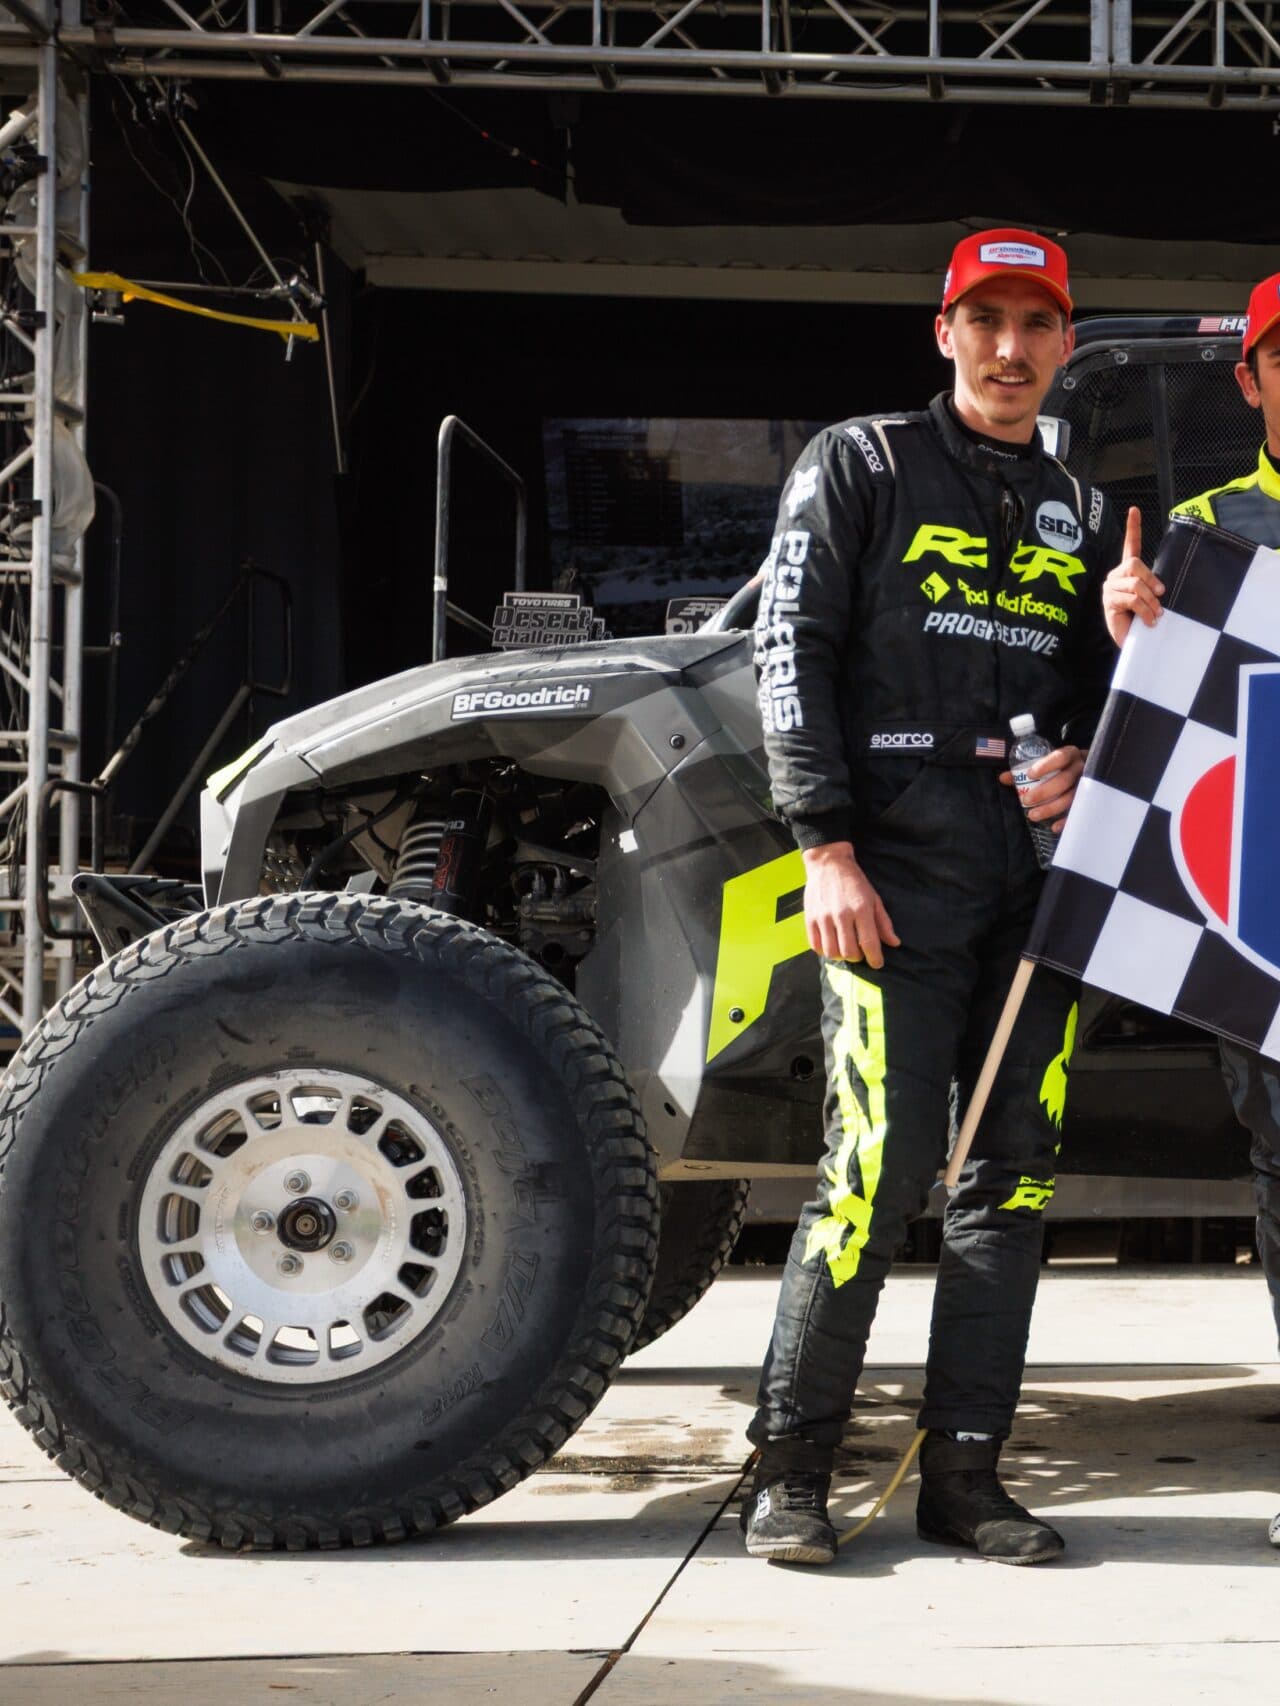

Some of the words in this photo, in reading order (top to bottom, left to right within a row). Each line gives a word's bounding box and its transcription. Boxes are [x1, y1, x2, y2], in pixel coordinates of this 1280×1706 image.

[541, 598, 572, 608] TIRES
[494, 607, 593, 630] Desert
[768, 530, 811, 733] POLARIS
[452, 684, 592, 714] BFGoodrich
[869, 732, 934, 749] sparco
